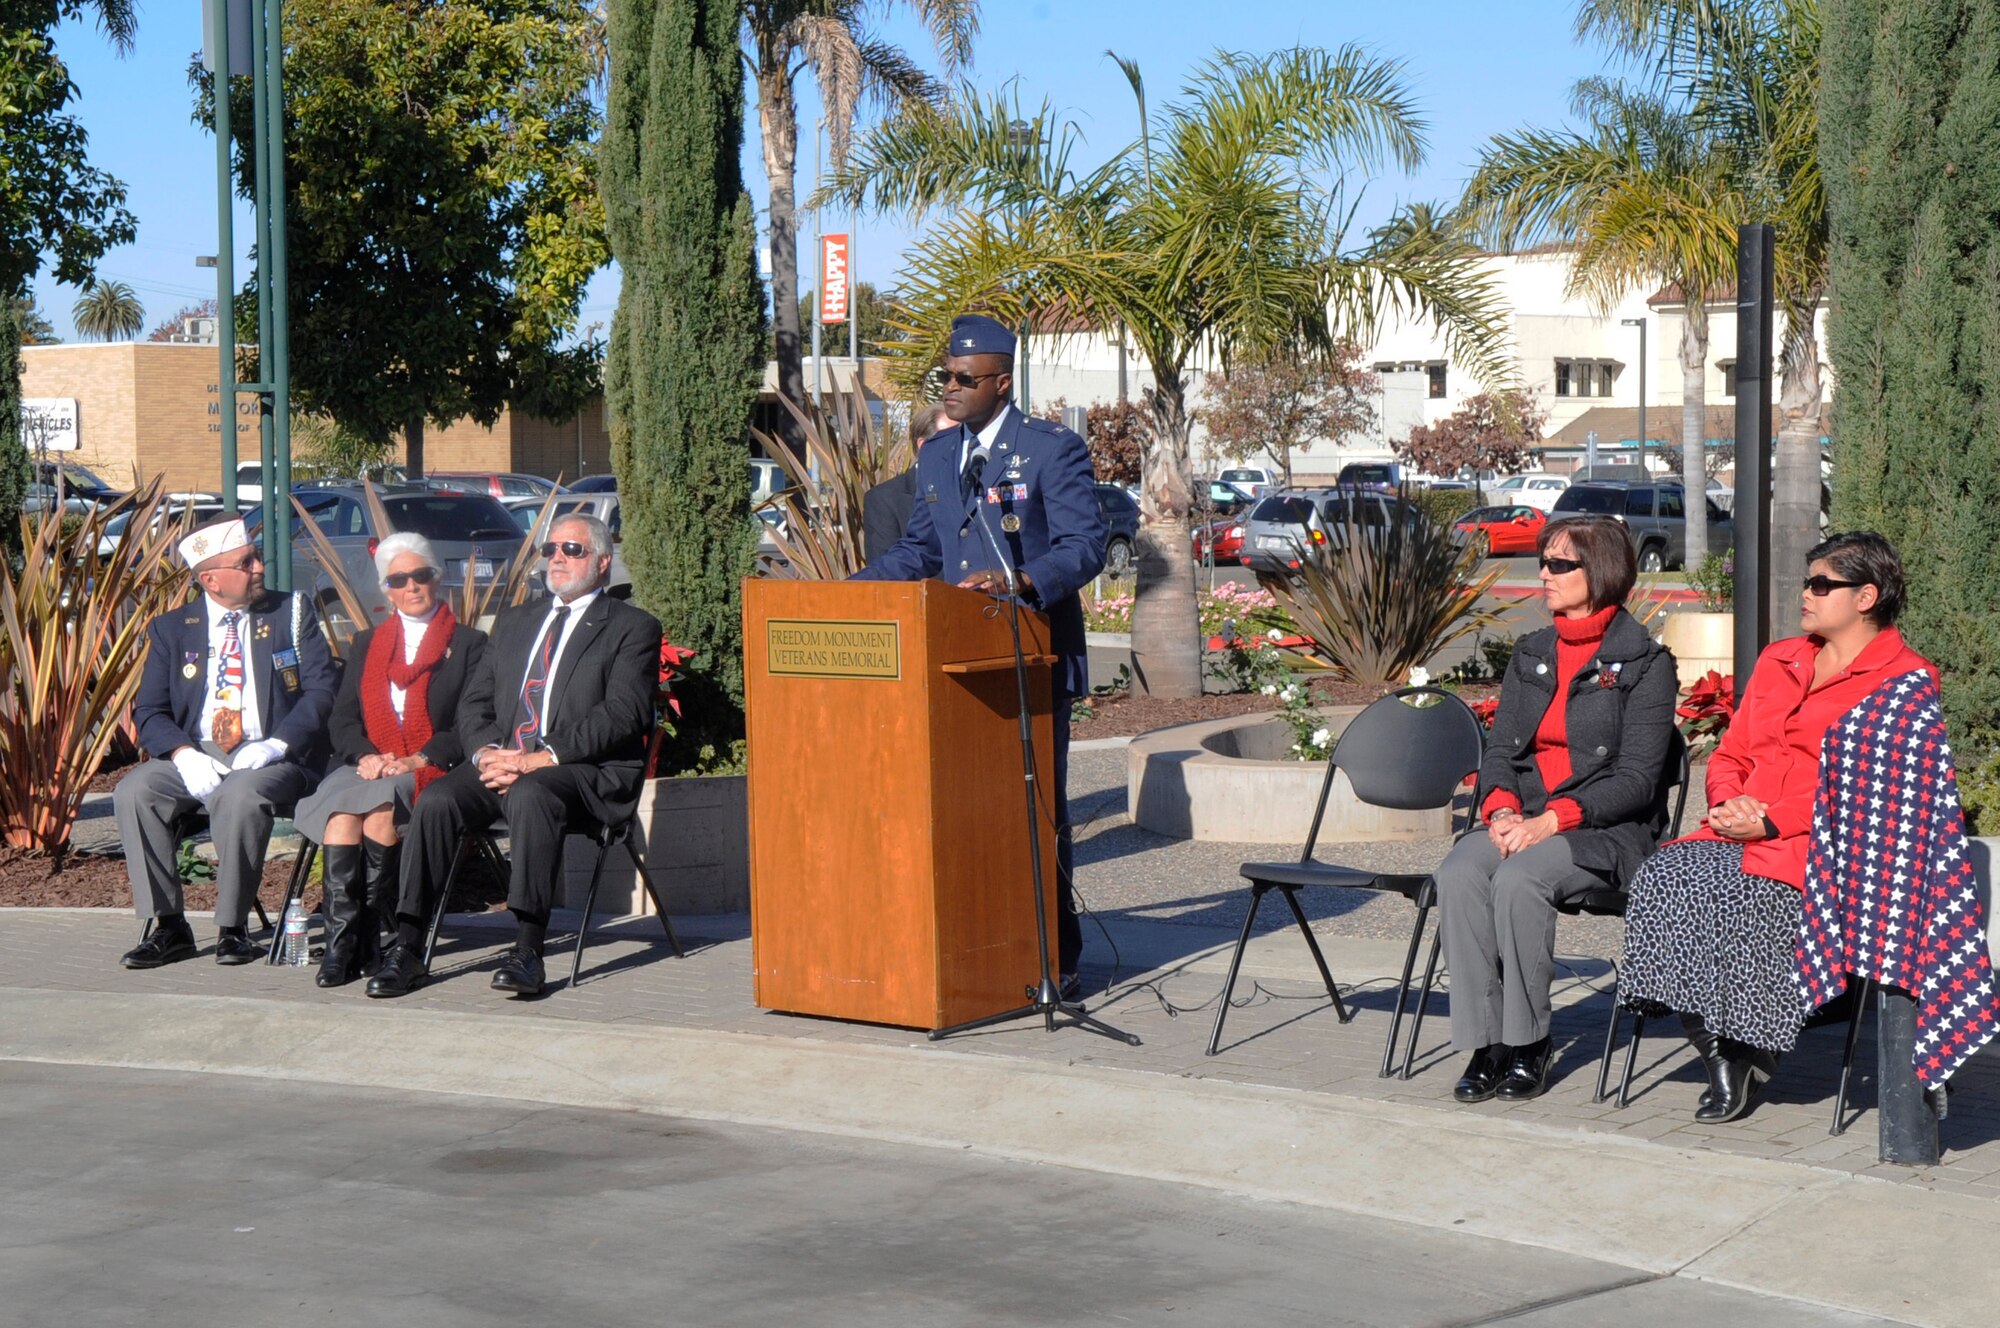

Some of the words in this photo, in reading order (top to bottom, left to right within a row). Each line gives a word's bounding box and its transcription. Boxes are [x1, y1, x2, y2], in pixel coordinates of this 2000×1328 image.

[825, 240, 845, 312] HAPPY
[208, 401, 259, 415] MOR
[771, 630, 820, 646] FREEDOM
[824, 631, 893, 648] MONUMENT
[774, 649, 828, 666] VETERANS
[831, 651, 892, 668] MEMORIAL
